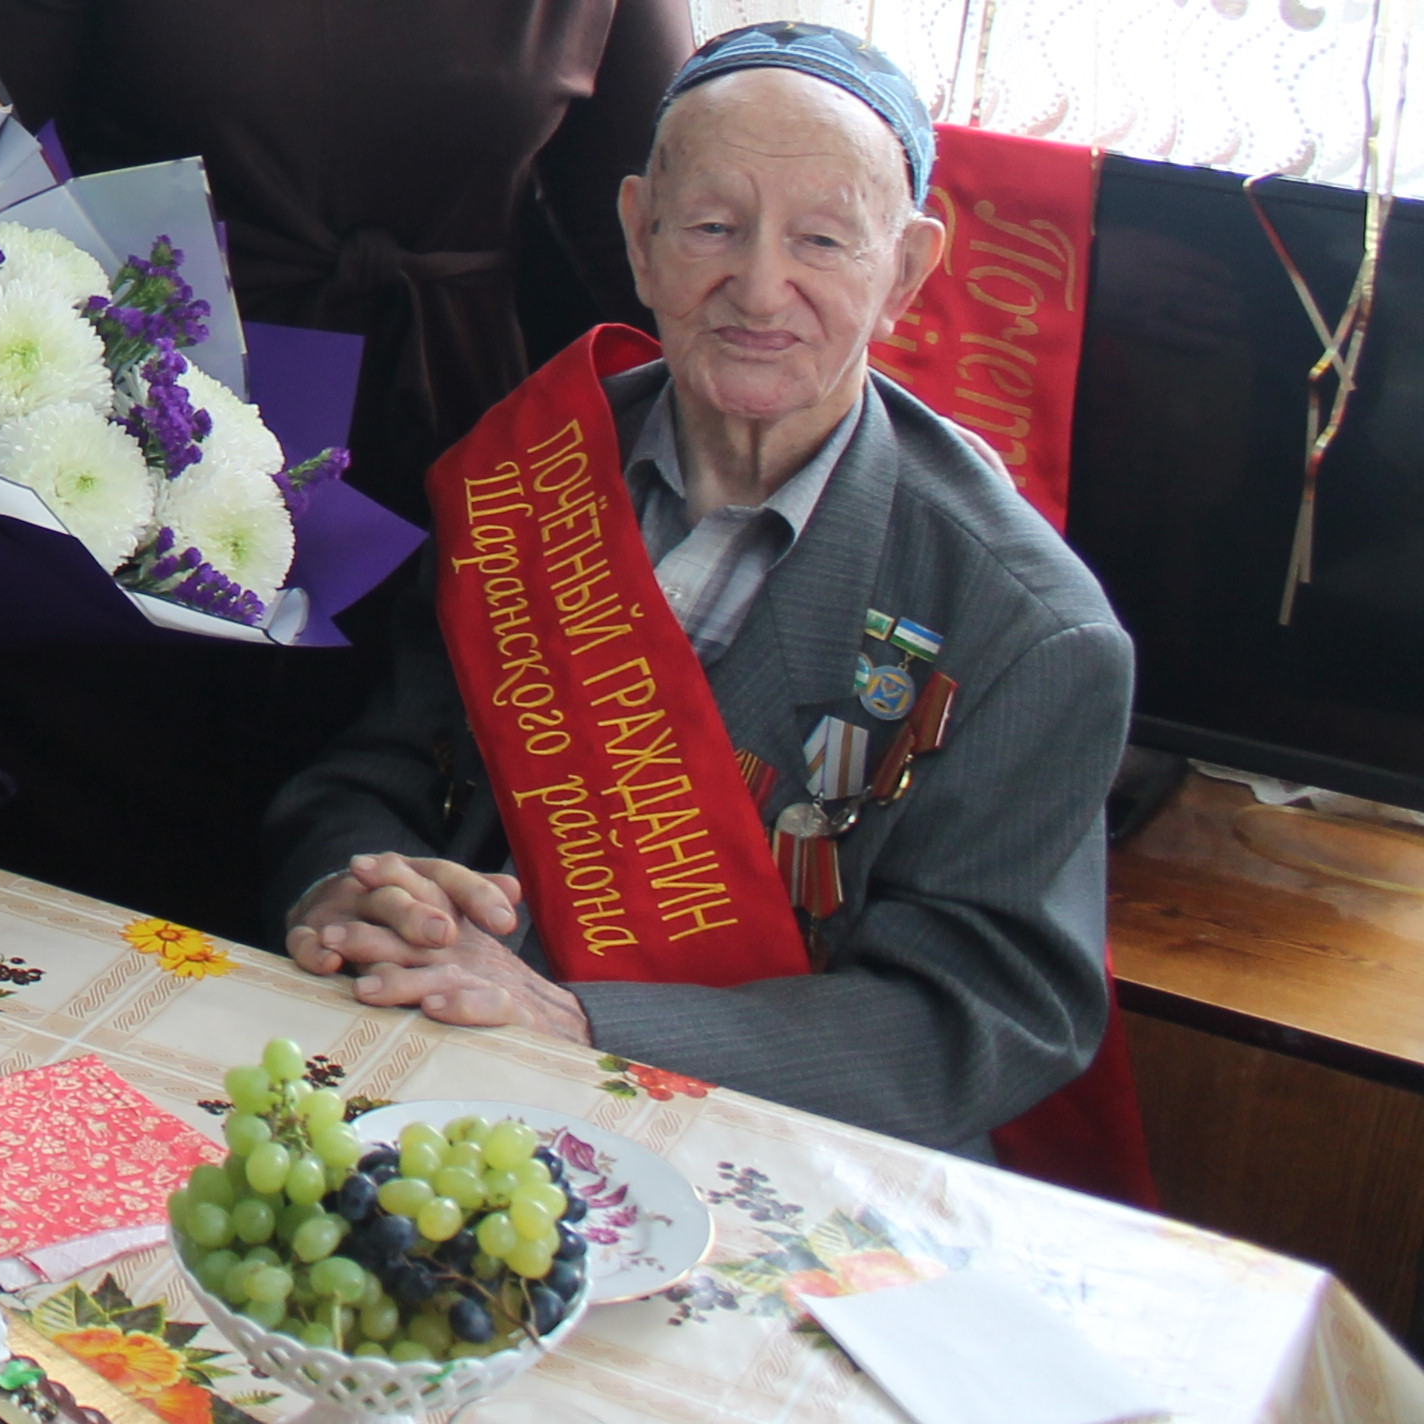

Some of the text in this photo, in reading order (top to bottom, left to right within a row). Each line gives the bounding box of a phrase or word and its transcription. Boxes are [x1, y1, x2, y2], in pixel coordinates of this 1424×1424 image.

[952, 199, 1076, 488] Почет
[451, 460, 639, 956] Шаранского района
[527, 419, 739, 942] ПОЧЁТНЫЙ ГРАЖДАНИН
